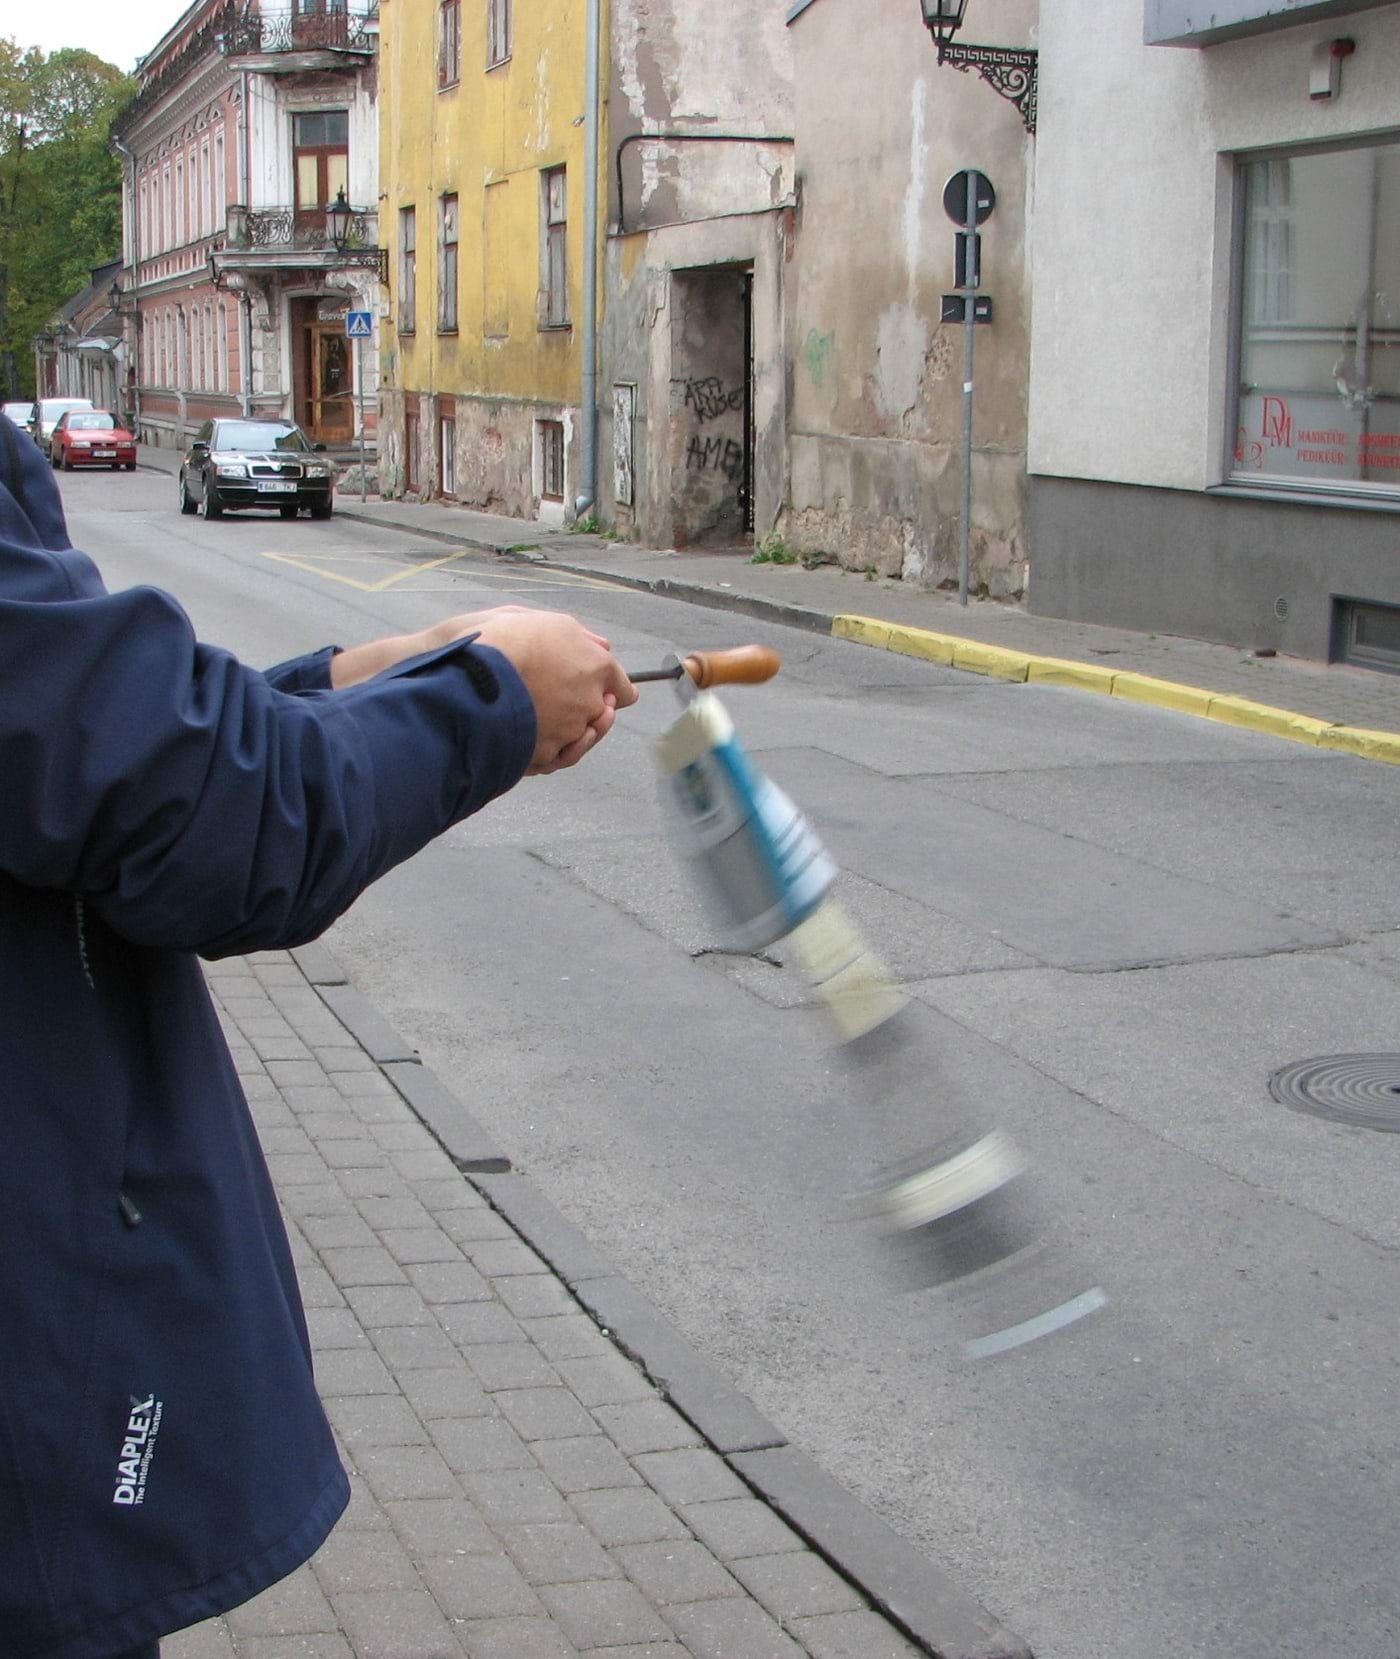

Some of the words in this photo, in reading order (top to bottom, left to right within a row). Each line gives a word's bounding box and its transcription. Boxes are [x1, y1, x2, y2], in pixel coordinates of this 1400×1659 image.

[148, 1401, 164, 1437] Texture
[137, 1438, 157, 1486] Intelligent
[134, 1487, 146, 1505] The
